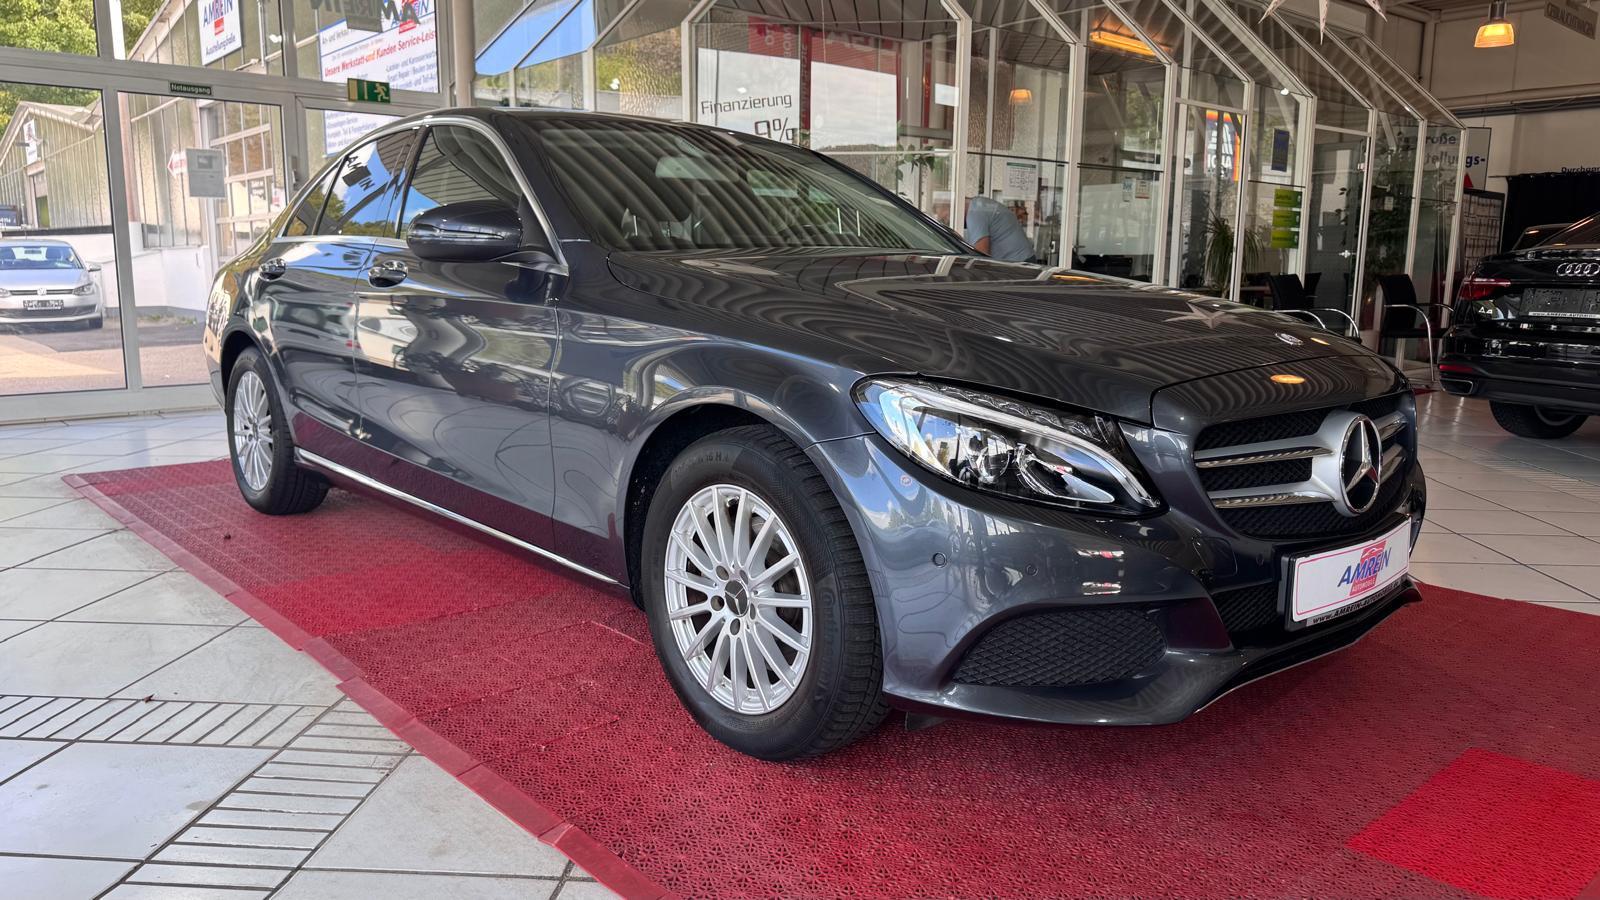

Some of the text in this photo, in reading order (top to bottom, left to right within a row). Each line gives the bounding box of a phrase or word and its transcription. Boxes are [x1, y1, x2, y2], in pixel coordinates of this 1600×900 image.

[171, 83, 211, 95] Notausgang
[701, 95, 792, 114] Finanzierung
[1425, 132, 1457, 144] roße
[1337, 547, 1392, 587] AMREIN
